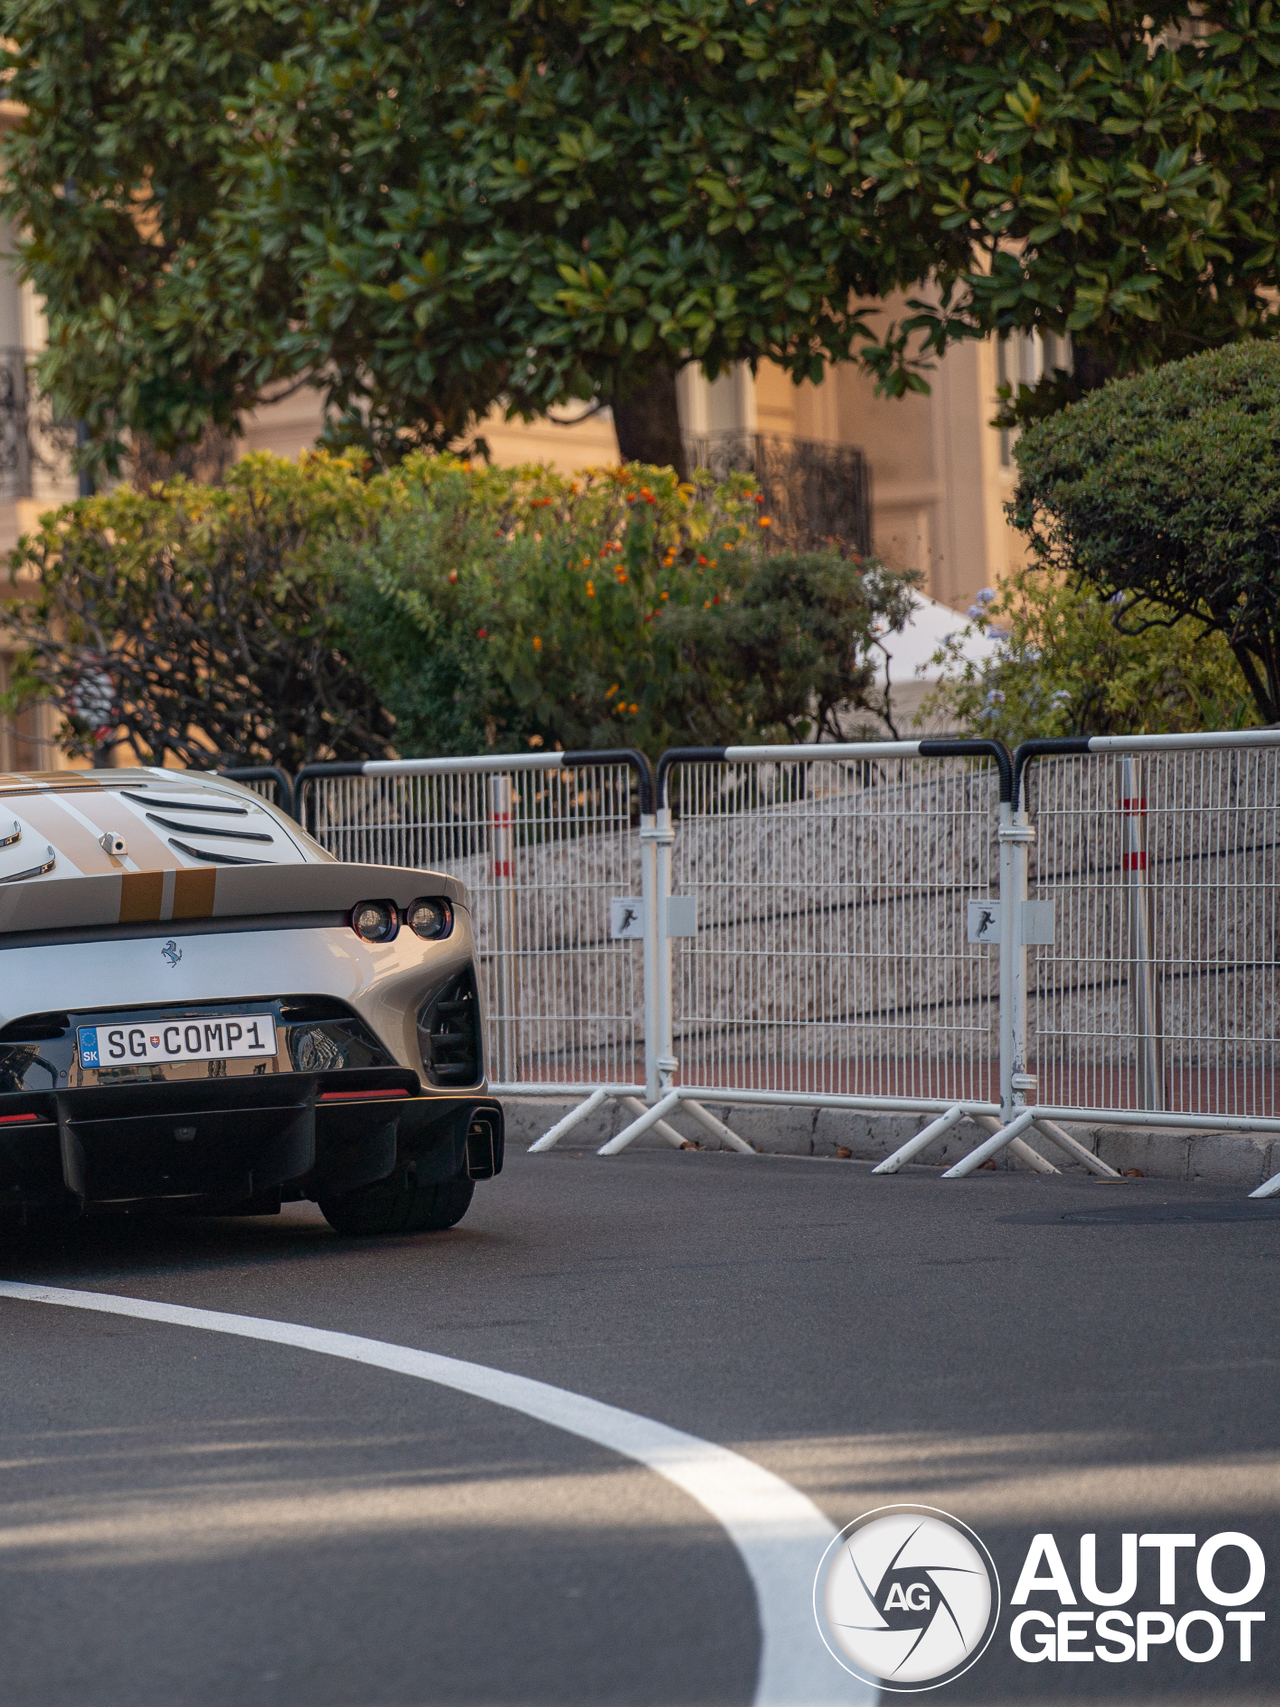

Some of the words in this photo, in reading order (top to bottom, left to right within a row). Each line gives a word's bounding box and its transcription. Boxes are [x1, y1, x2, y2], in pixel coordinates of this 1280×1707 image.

[108, 1029, 147, 1059] SG
[163, 1021, 265, 1054] COMP1
[83, 1051, 98, 1062] SK
